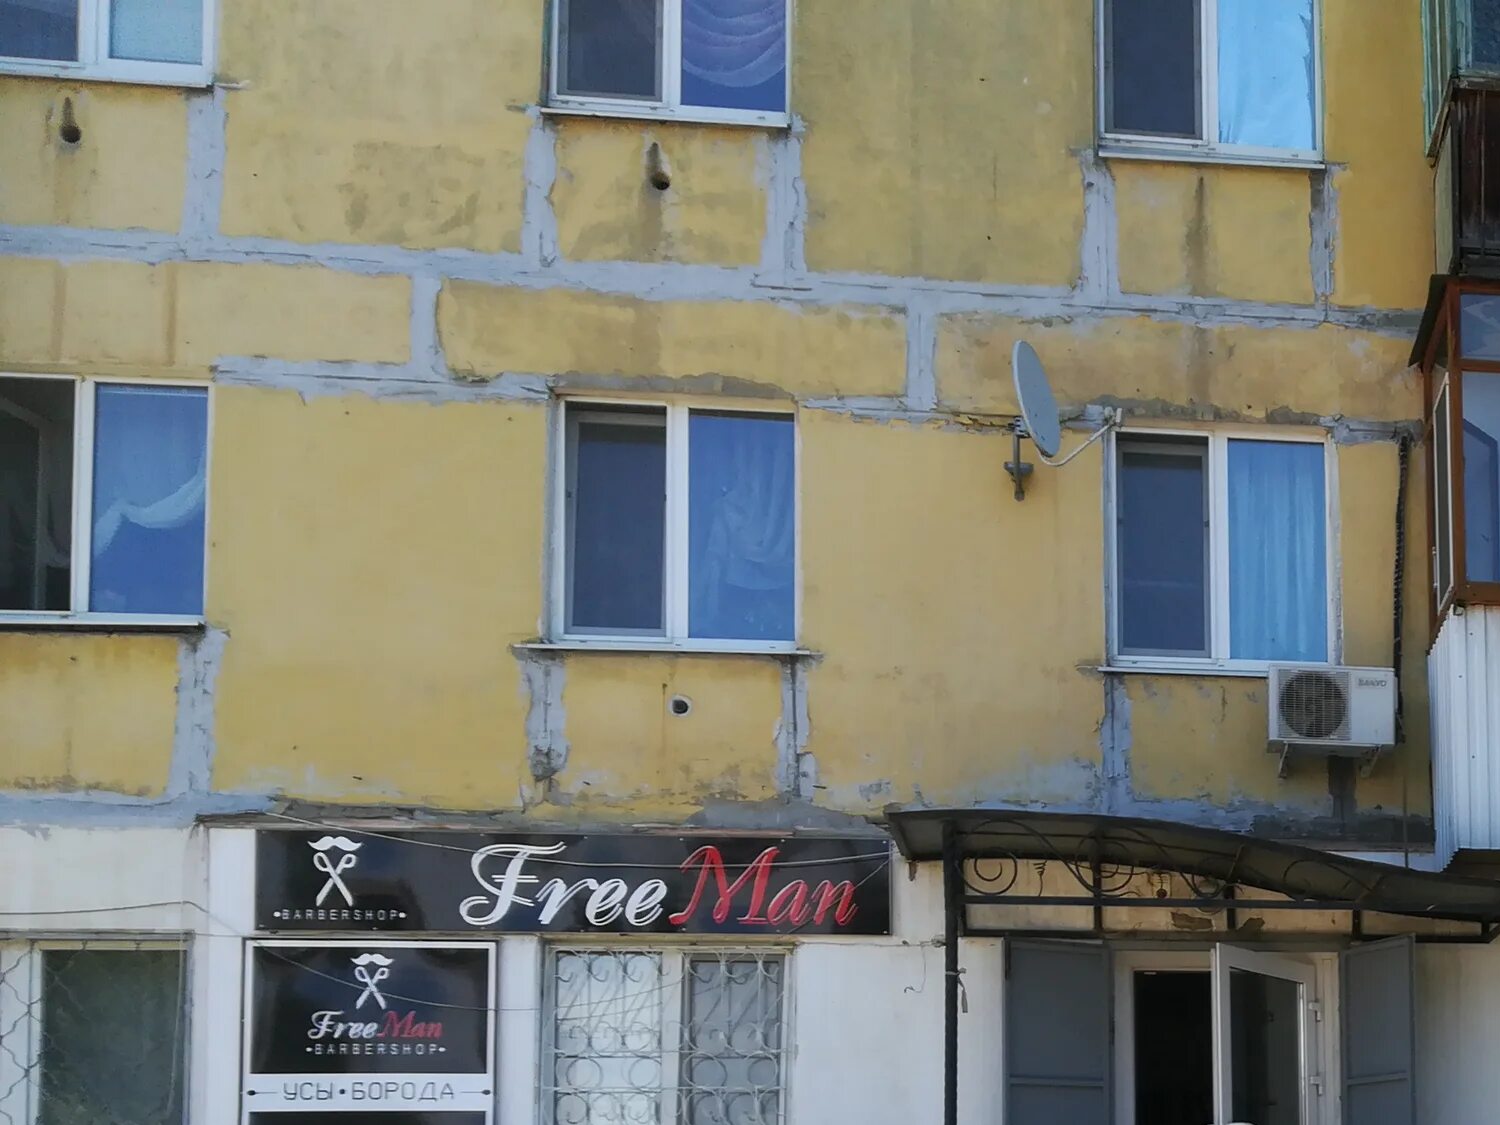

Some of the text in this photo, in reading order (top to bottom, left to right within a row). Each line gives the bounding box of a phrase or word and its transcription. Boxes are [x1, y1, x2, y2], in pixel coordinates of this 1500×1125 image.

[459, 841, 860, 928] Free Man
[281, 908, 399, 921] BARBERSHOP
[307, 1009, 443, 1040] Free Man
[314, 1043, 439, 1056] BARBERSHOP
[283, 1081, 455, 1102] УСЫ БОРОДА
